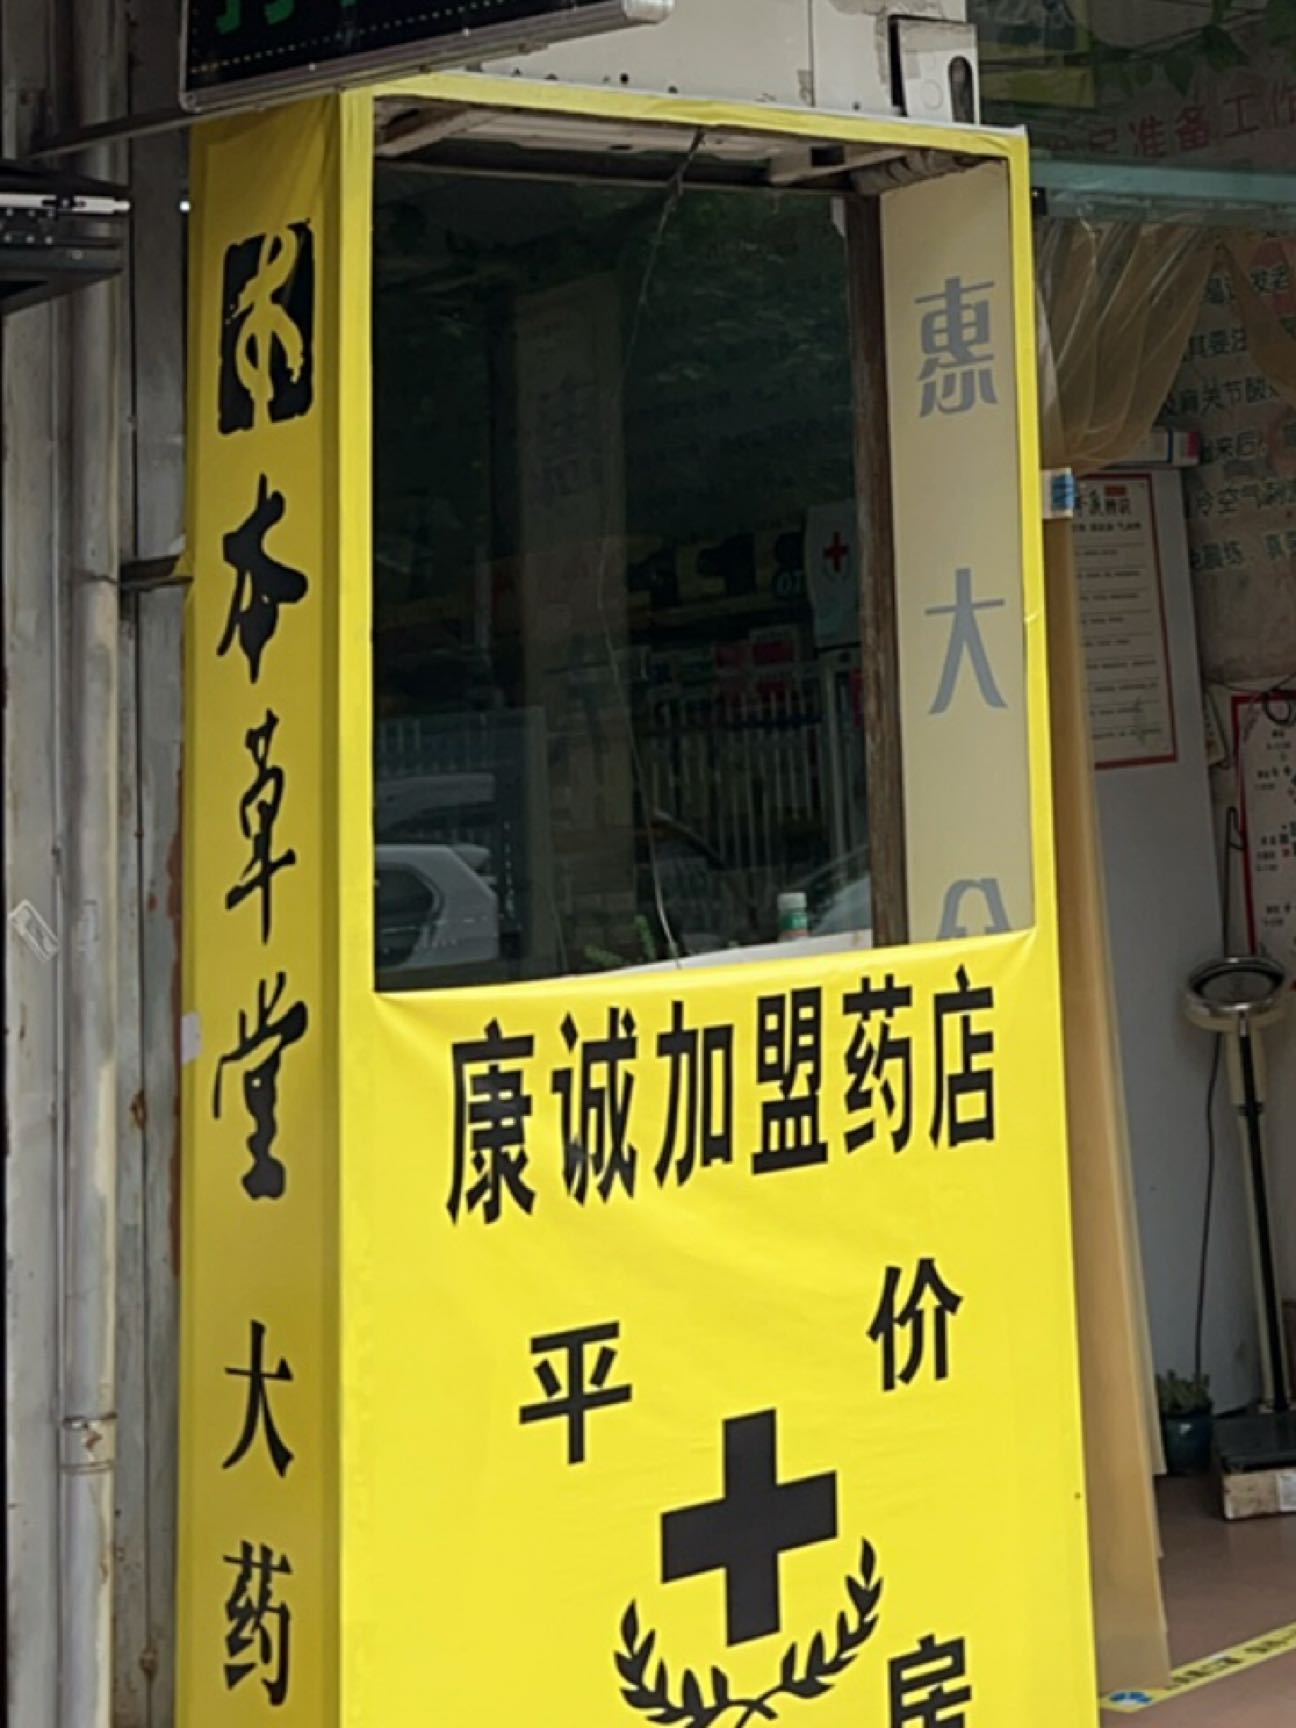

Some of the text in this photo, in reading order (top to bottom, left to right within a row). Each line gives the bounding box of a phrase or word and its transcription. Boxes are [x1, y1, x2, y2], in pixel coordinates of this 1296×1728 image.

[447, 964, 997, 1225] 康诚加盟药店
